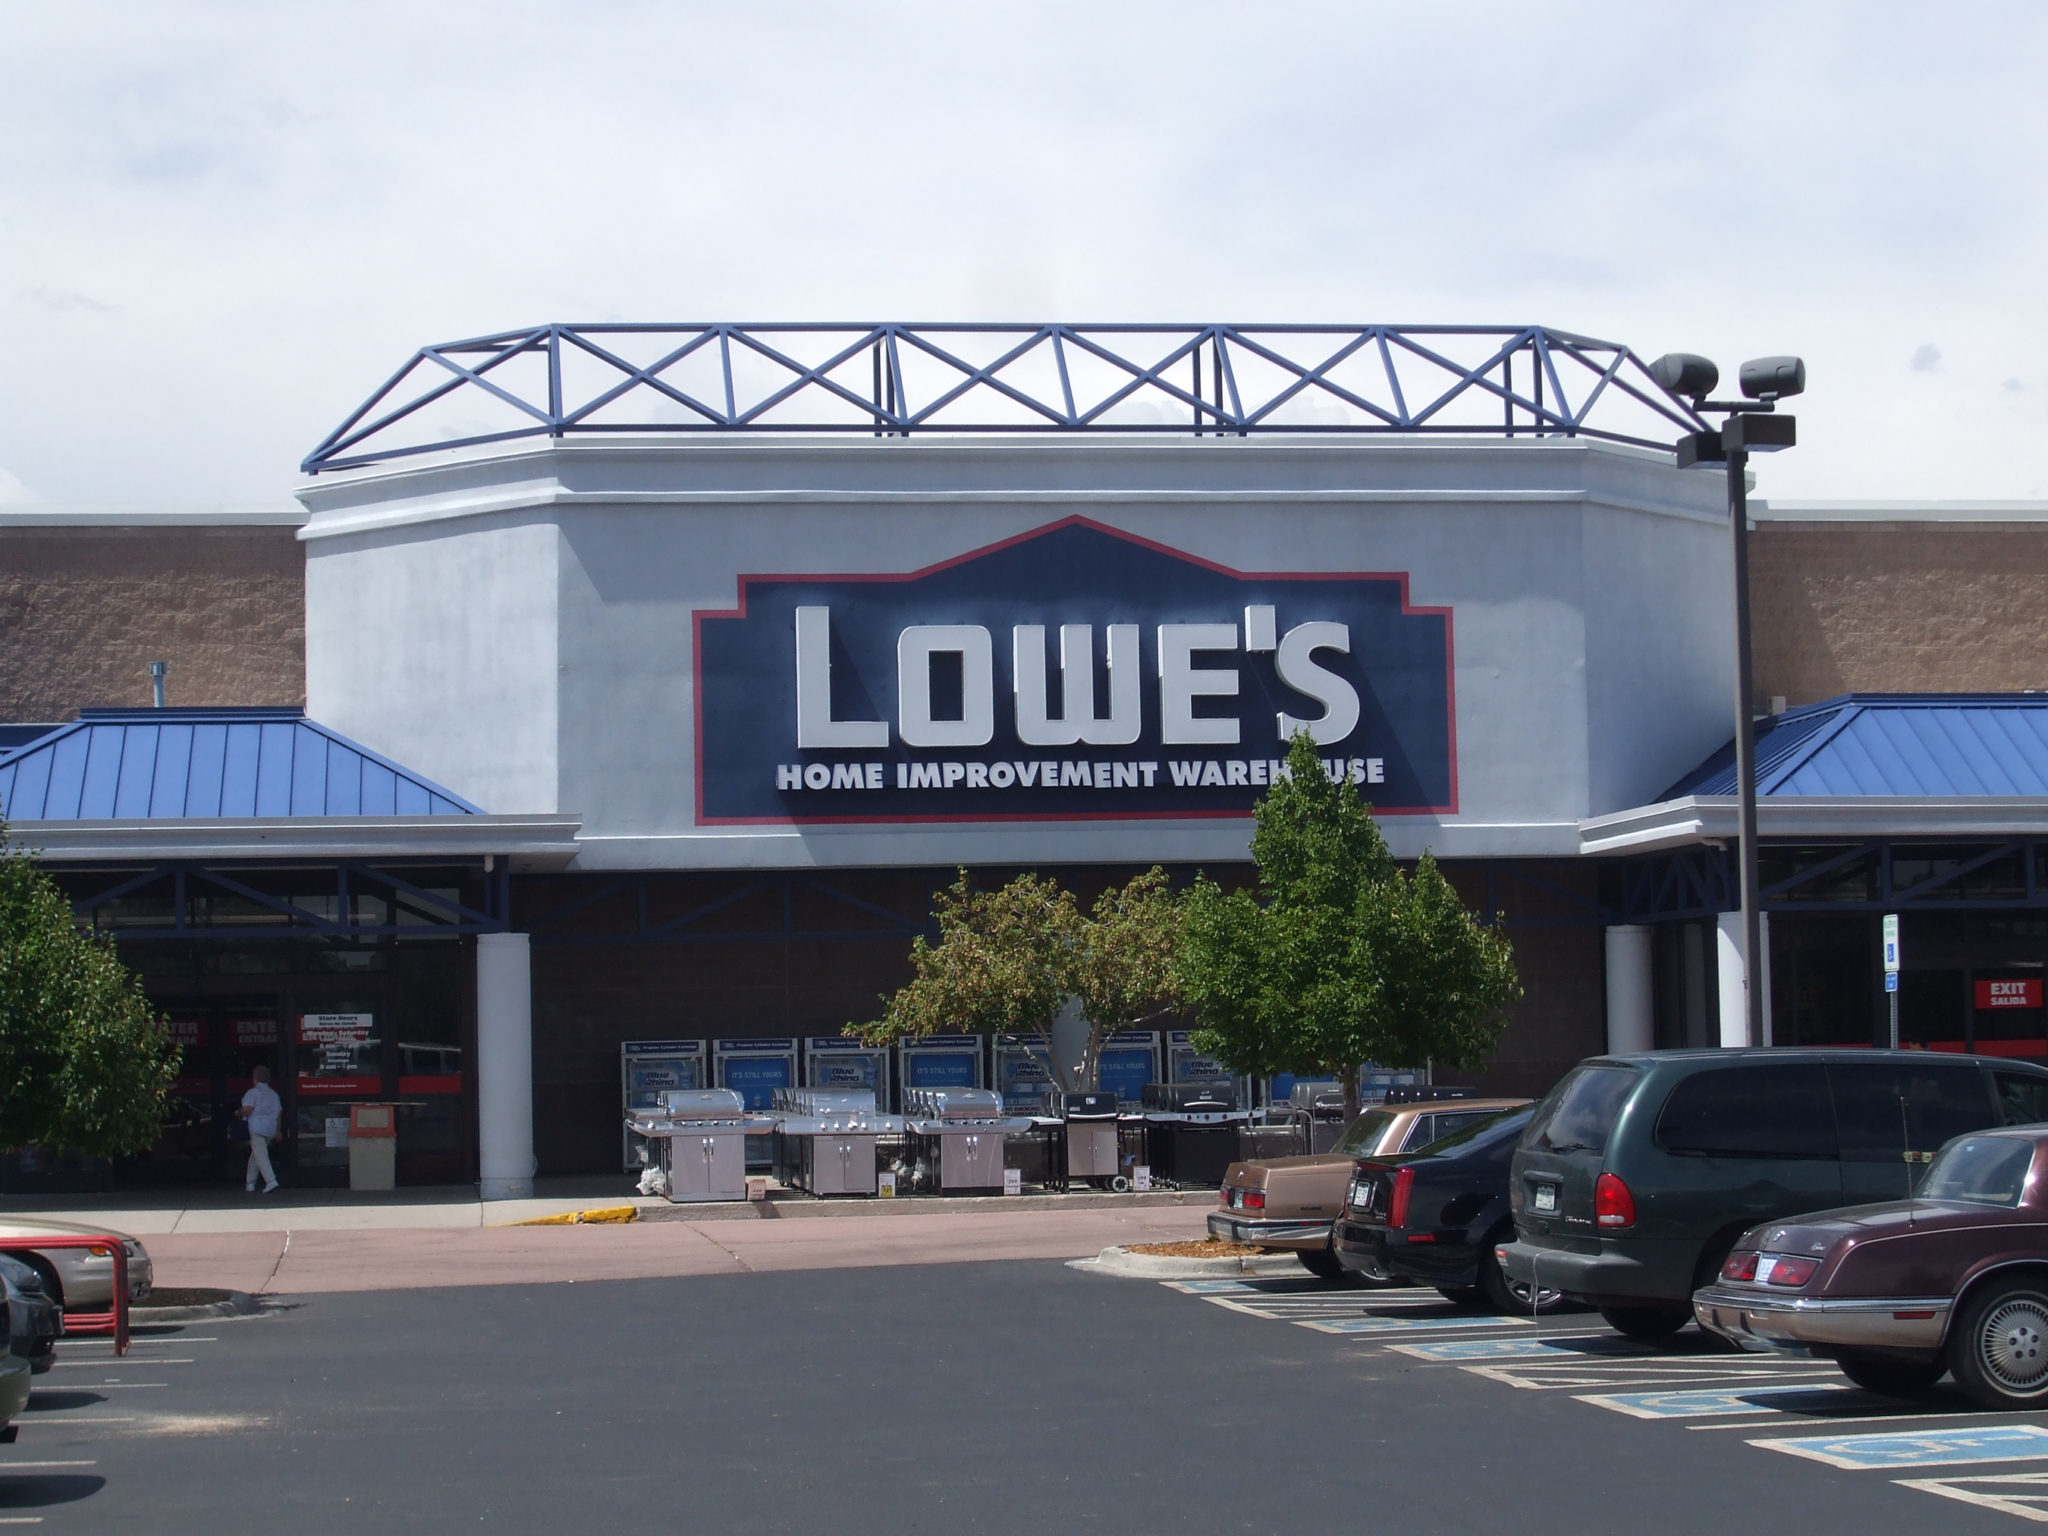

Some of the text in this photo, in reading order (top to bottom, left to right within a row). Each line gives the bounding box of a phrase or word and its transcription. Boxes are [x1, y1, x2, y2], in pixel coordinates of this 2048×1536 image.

[795, 604, 1360, 748] LOWE'S
[777, 758, 1385, 790] HOME IMPROVEMENT WAREHUSE
[1990, 982, 2026, 995] EXIT
[1990, 996, 2026, 1006] SALIDA
[237, 1021, 277, 1033] ENTE
